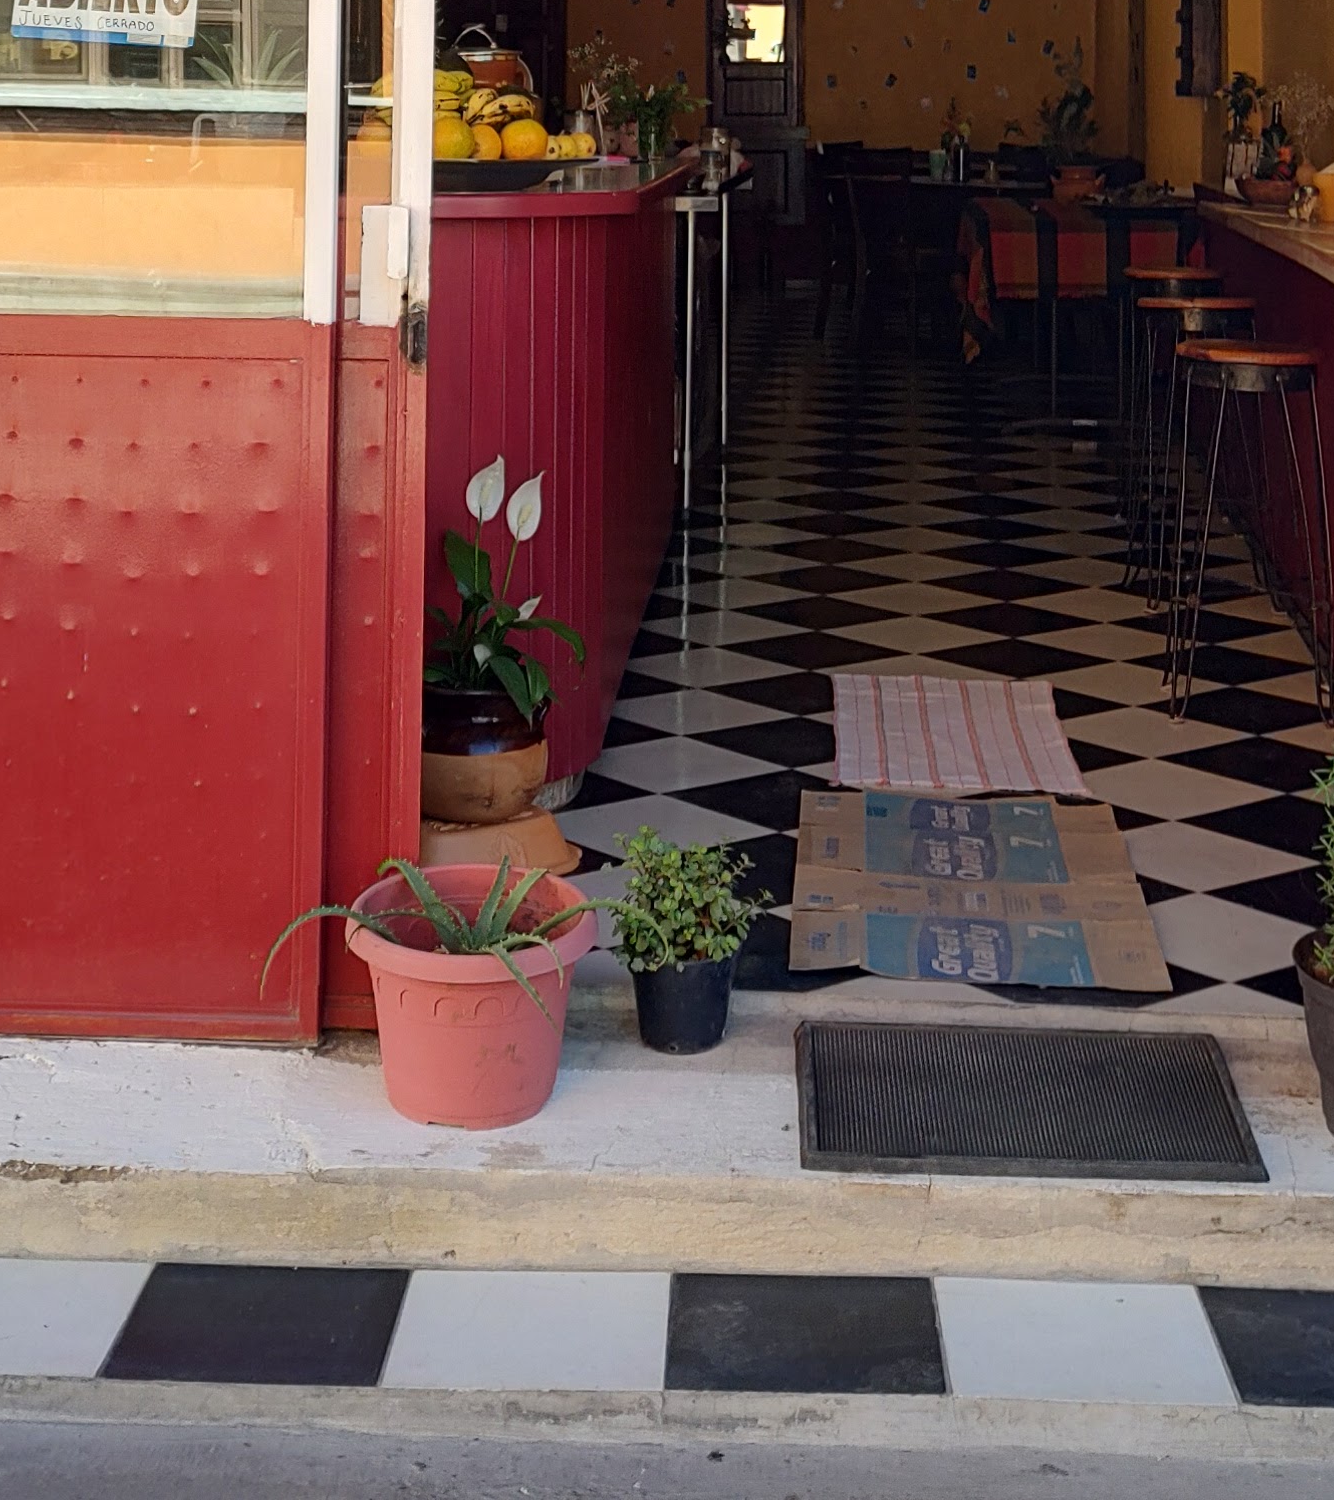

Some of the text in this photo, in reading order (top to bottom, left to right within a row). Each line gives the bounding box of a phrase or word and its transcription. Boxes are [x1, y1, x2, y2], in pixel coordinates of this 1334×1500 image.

[19, 9, 155, 32] JUEVES CERRADO
[929, 925, 964, 976] Great
[964, 923, 1000, 982] Quality
